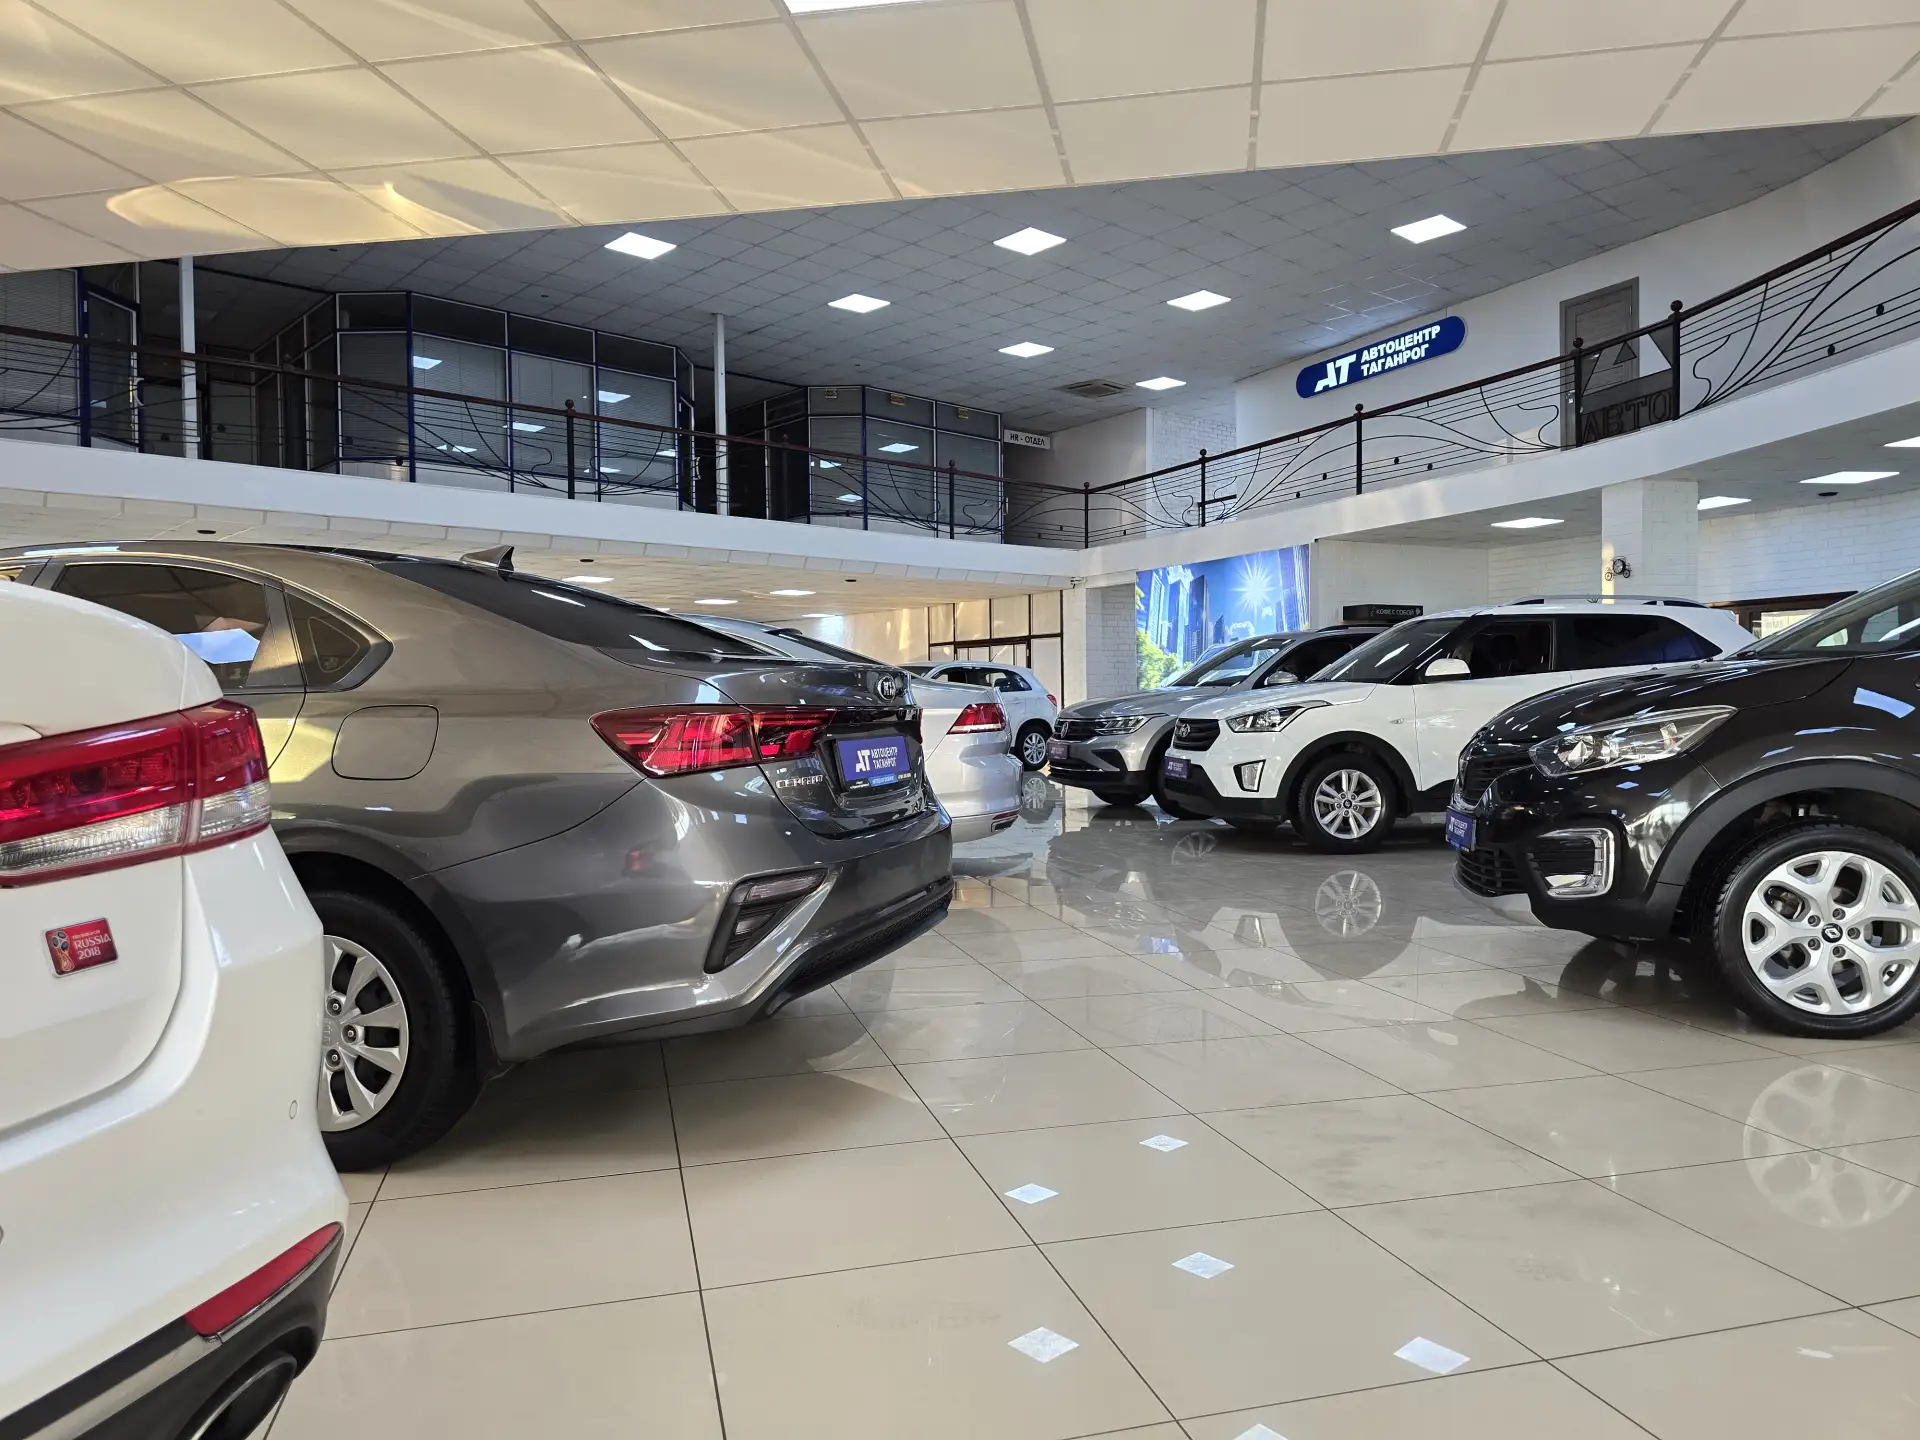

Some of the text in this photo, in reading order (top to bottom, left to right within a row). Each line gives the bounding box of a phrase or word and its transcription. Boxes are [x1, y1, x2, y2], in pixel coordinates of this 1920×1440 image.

[1361, 325, 1441, 363] АВТОЦЕНТР
[1361, 344, 1429, 377] ТАГАНРОГ
[74, 933, 112, 950] RUSSIA
[77, 946, 102, 960] 2018
